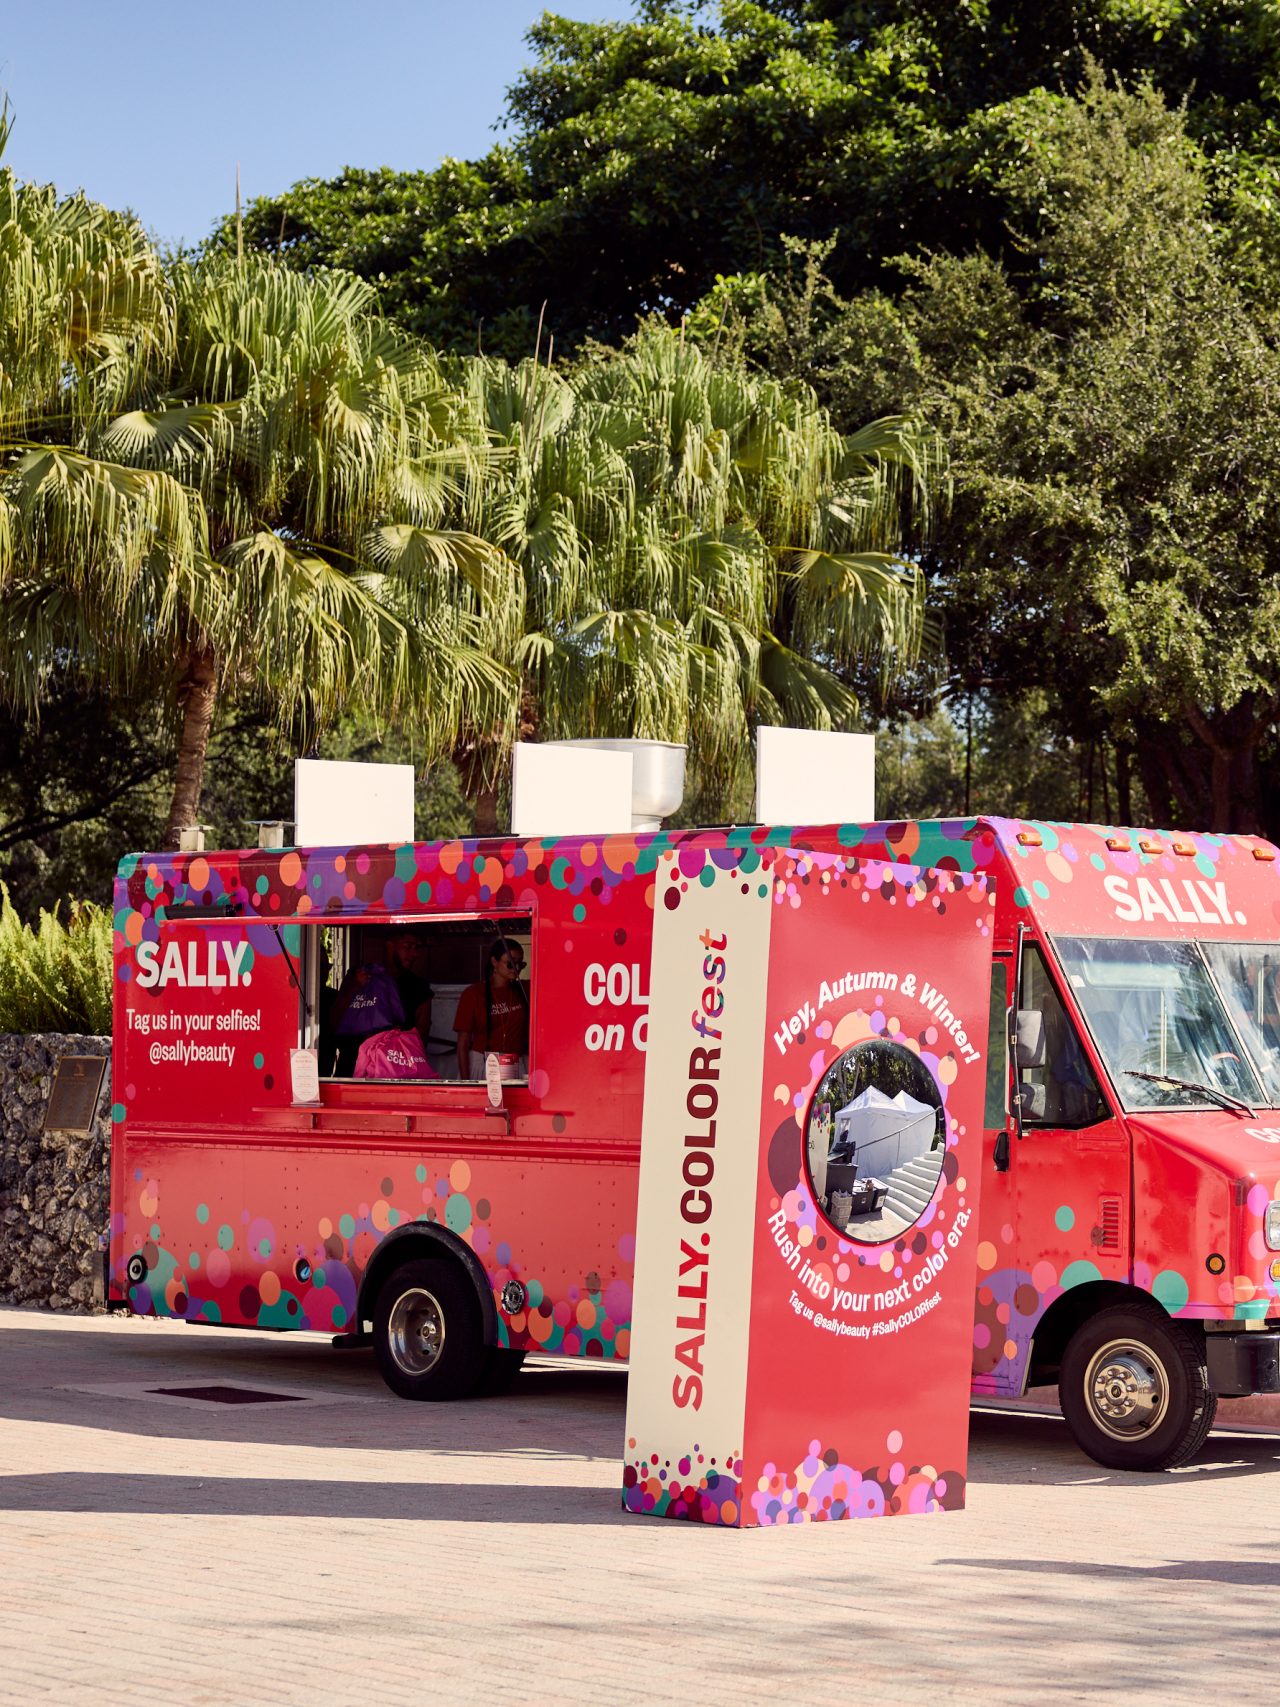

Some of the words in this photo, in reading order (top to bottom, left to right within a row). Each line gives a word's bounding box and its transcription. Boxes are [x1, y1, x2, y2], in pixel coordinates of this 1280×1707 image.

[1103, 874, 1247, 926] SALLY.
[136, 940, 252, 988] SALLY.
[583, 962, 651, 1006] COL
[126, 1008, 150, 1035] Tag
[152, 1014, 167, 1031] us
[170, 1009, 182, 1030] in
[184, 1014, 214, 1036] your
[216, 1008, 261, 1031] selfies!
[584, 1023, 625, 1051] on
[773, 1001, 816, 1055] Hey,
[818, 971, 898, 1010] Autumn
[900, 973, 917, 998] &
[919, 982, 981, 1064] Winter!
[149, 1039, 236, 1067] @sallybeauty
[680, 928, 727, 1224] COLORfest
[767, 1208, 802, 1271] Rush
[797, 1257, 831, 1300] into
[832, 1286, 870, 1312] your
[874, 1279, 912, 1312] next
[913, 1245, 950, 1292] color
[947, 1207, 973, 1247] era.
[672, 1232, 710, 1412] SALLY.
[788, 1290, 803, 1315] Tag
[802, 1304, 814, 1321] us
[813, 1313, 871, 1340] @sallybeauty
[872, 1291, 943, 1337] #SallyCOLORfest
